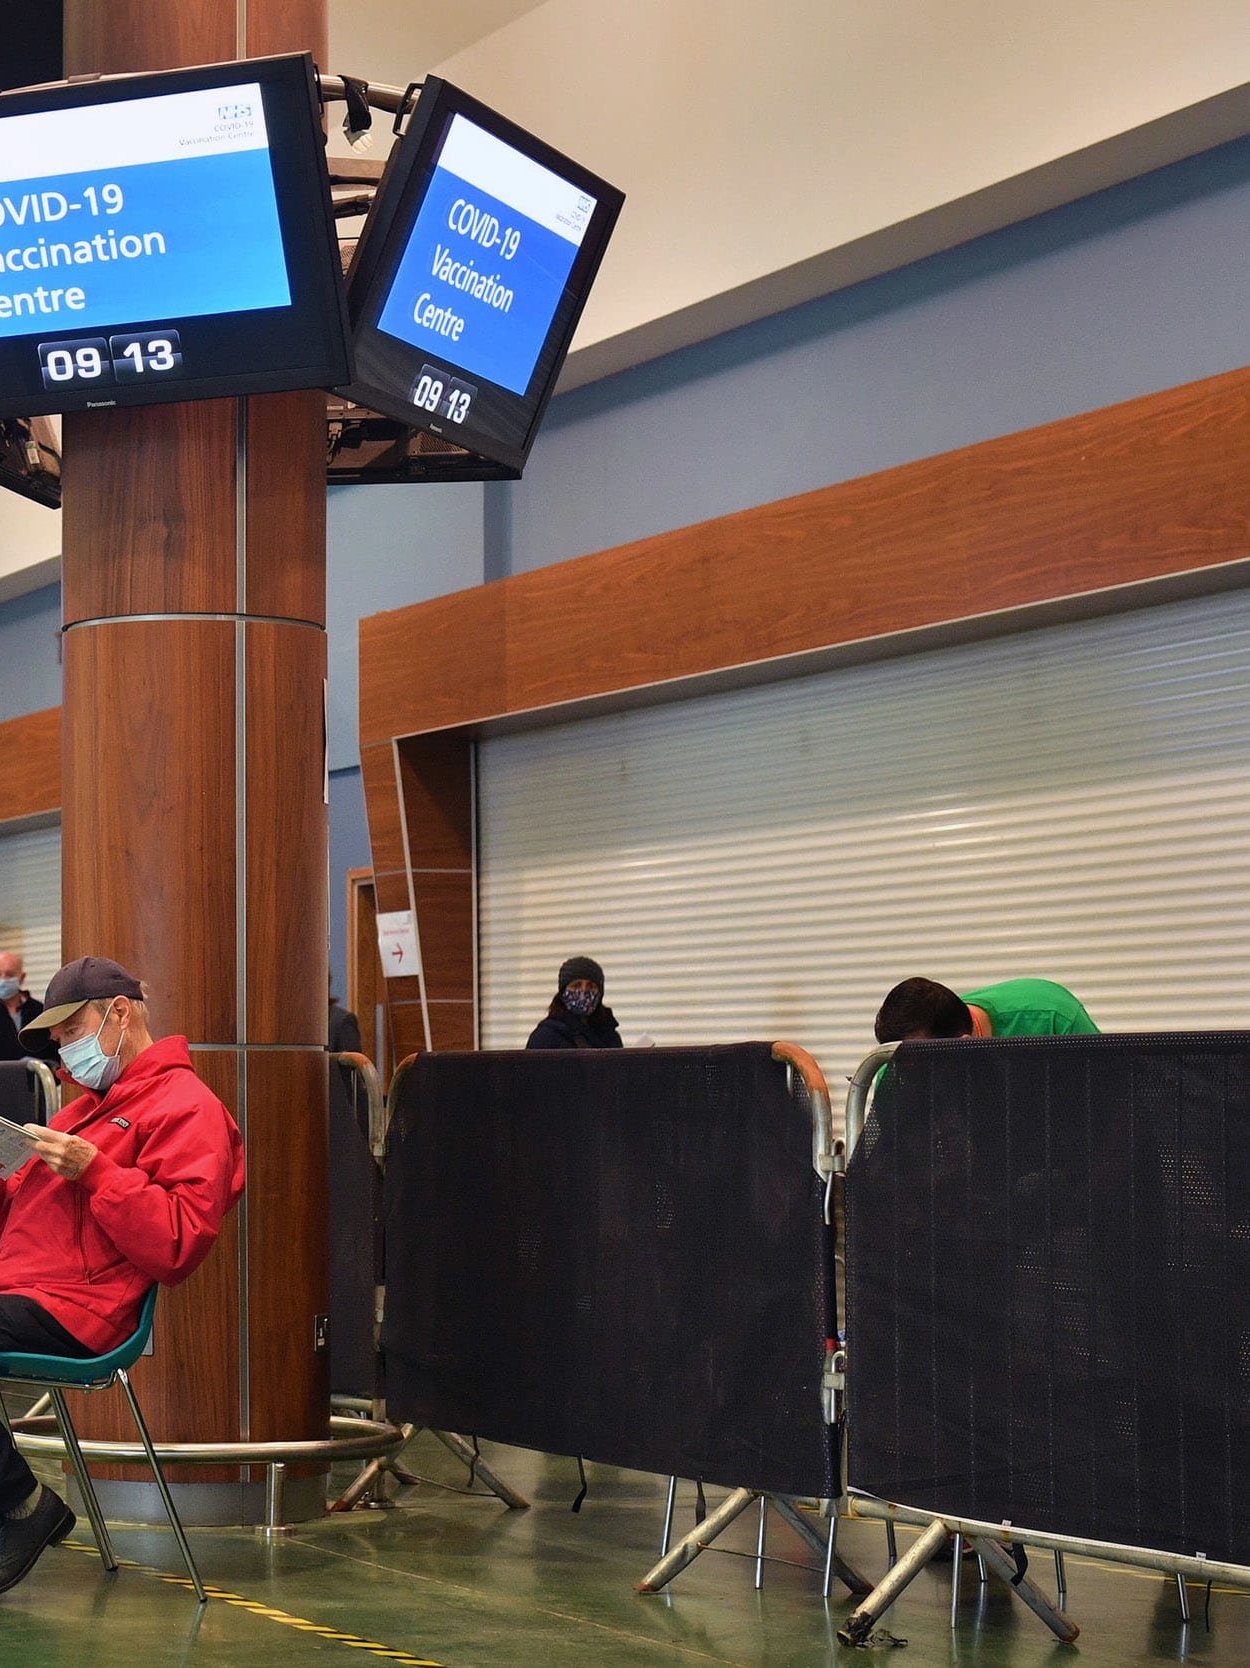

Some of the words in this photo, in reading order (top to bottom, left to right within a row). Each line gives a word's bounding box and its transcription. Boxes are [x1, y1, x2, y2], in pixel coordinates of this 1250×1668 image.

[448, 198, 521, 261] COVID-19
[431, 244, 514, 313] Vaccination
[413, 293, 465, 342] Centre
[47, 346, 102, 381] 09
[123, 339, 175, 373] 13
[414, 376, 442, 411] 09
[446, 389, 471, 424] 13
